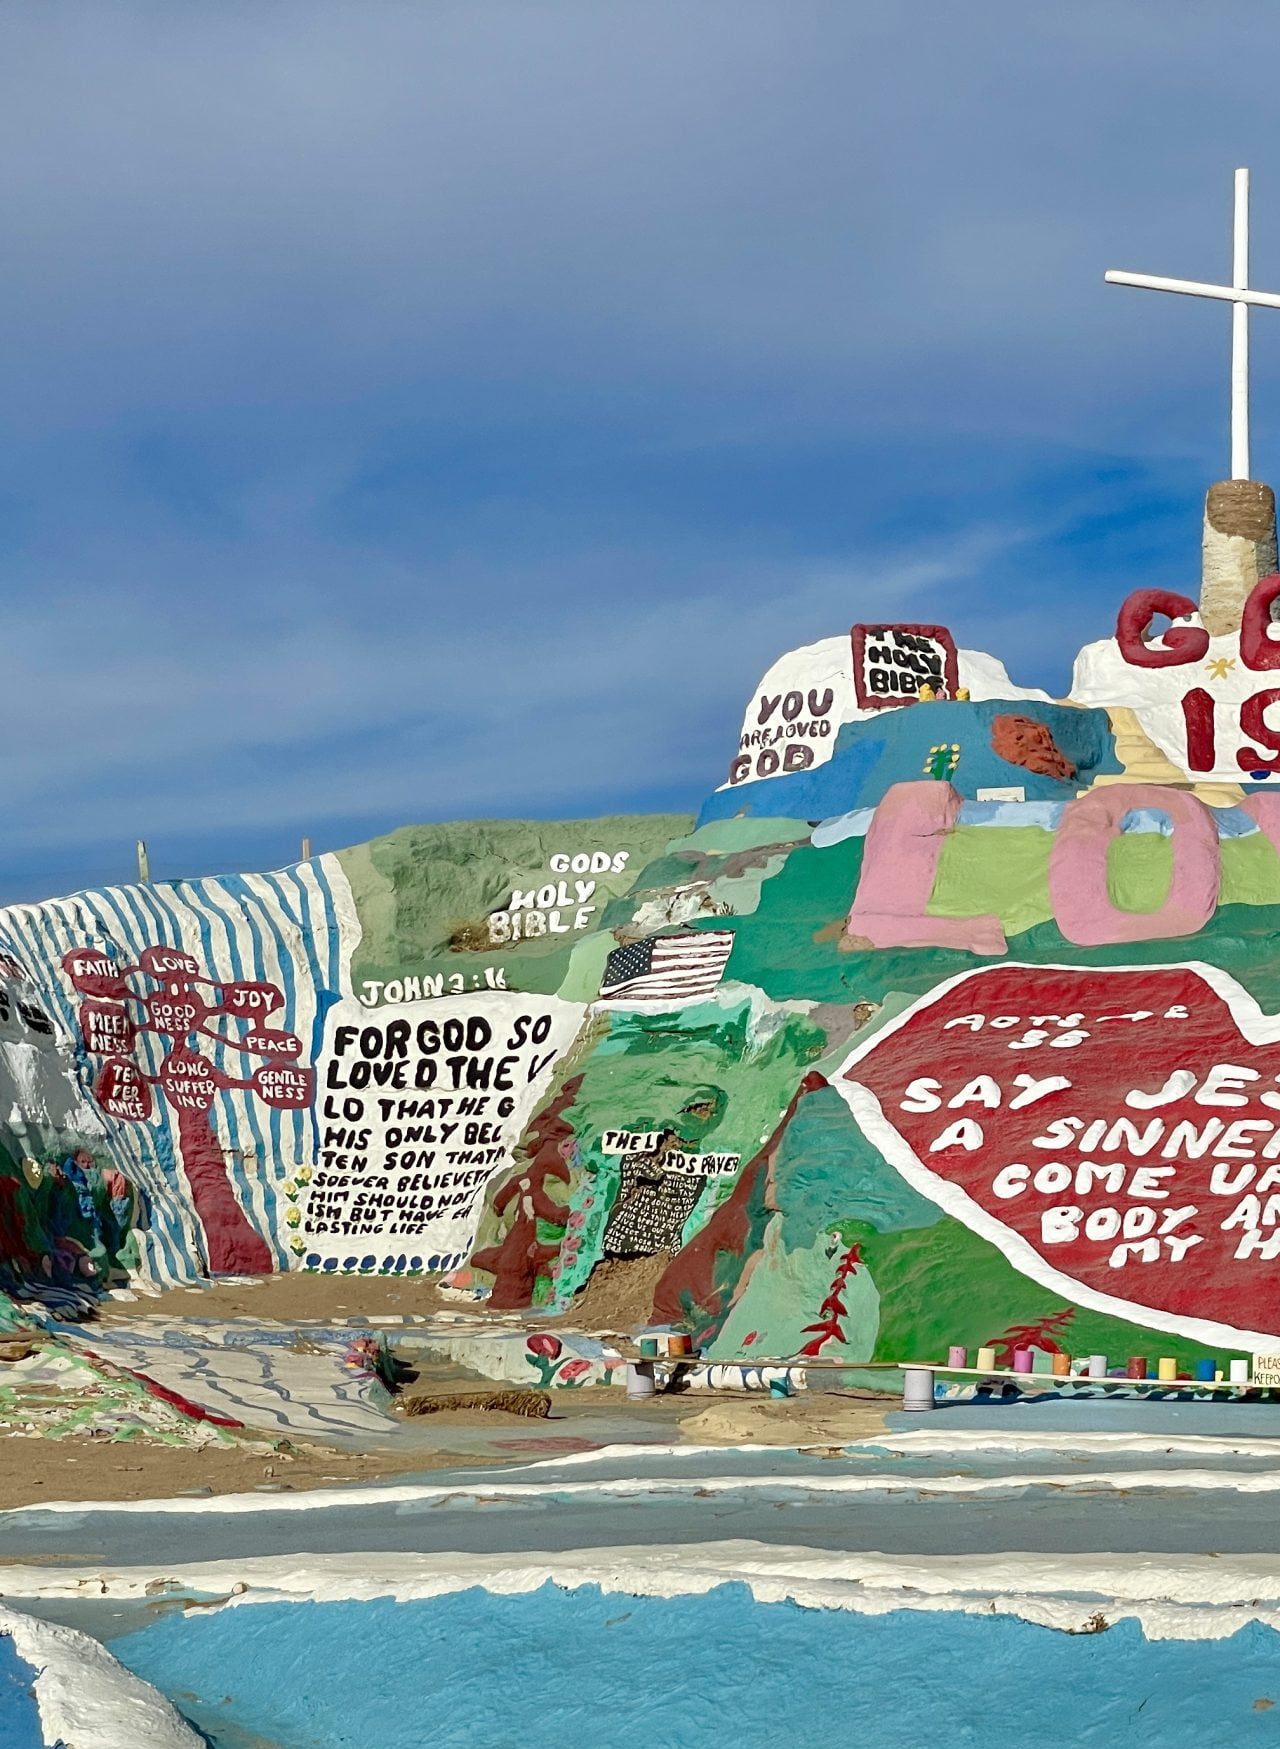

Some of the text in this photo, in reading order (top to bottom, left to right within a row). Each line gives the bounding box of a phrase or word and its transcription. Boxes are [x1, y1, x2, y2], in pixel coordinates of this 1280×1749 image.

[868, 646, 942, 675] HOLY
[757, 688, 834, 725] YOU
[740, 719, 831, 750] ARE LOVED
[730, 744, 814, 785] GOD
[550, 851, 630, 874] GODS
[508, 880, 596, 911] HOLY
[487, 905, 596, 944] BIBLE
[73, 959, 119, 978] FAITH
[152, 957, 196, 974] LOVE
[232, 989, 274, 1011] JOY
[360, 972, 444, 1006] JOHN
[150, 1002, 195, 1018] GOOD
[155, 1017, 190, 1032] NESS
[90, 1033, 128, 1053] NESS
[246, 1036, 297, 1052] PEACE
[334, 1014, 552, 1060] FOR GOD SO
[167, 1061, 210, 1077] LONG
[257, 1070, 307, 1087] GENTLE
[326, 1058, 438, 1090] LOVED
[446, 1056, 520, 1091] THE
[166, 1078, 216, 1095] SUFFER
[262, 1086, 305, 1101] NESS
[900, 1074, 1072, 1113] SAY
[177, 1095, 208, 1109] ING
[378, 1098, 453, 1122] THAT
[456, 1096, 491, 1116] HE
[324, 1126, 372, 1151] HIS
[385, 1122, 459, 1148] ONLY
[606, 1132, 641, 1150] THE
[929, 1118, 984, 1153] A
[322, 1151, 368, 1173] TEN
[383, 1150, 436, 1170] SON
[312, 1172, 389, 1189] SOEVER
[992, 1160, 1176, 1199] COME
[310, 1190, 349, 1203] HIM
[353, 1192, 434, 1210] SHOULD
[438, 1189, 472, 1208] NOT
[350, 1207, 393, 1222] BUT
[399, 1208, 444, 1223] HAVE
[1040, 1204, 1198, 1244] BODY
[305, 1220, 429, 1236] LASTING LIFE
[1109, 1235, 1205, 1268] MY
